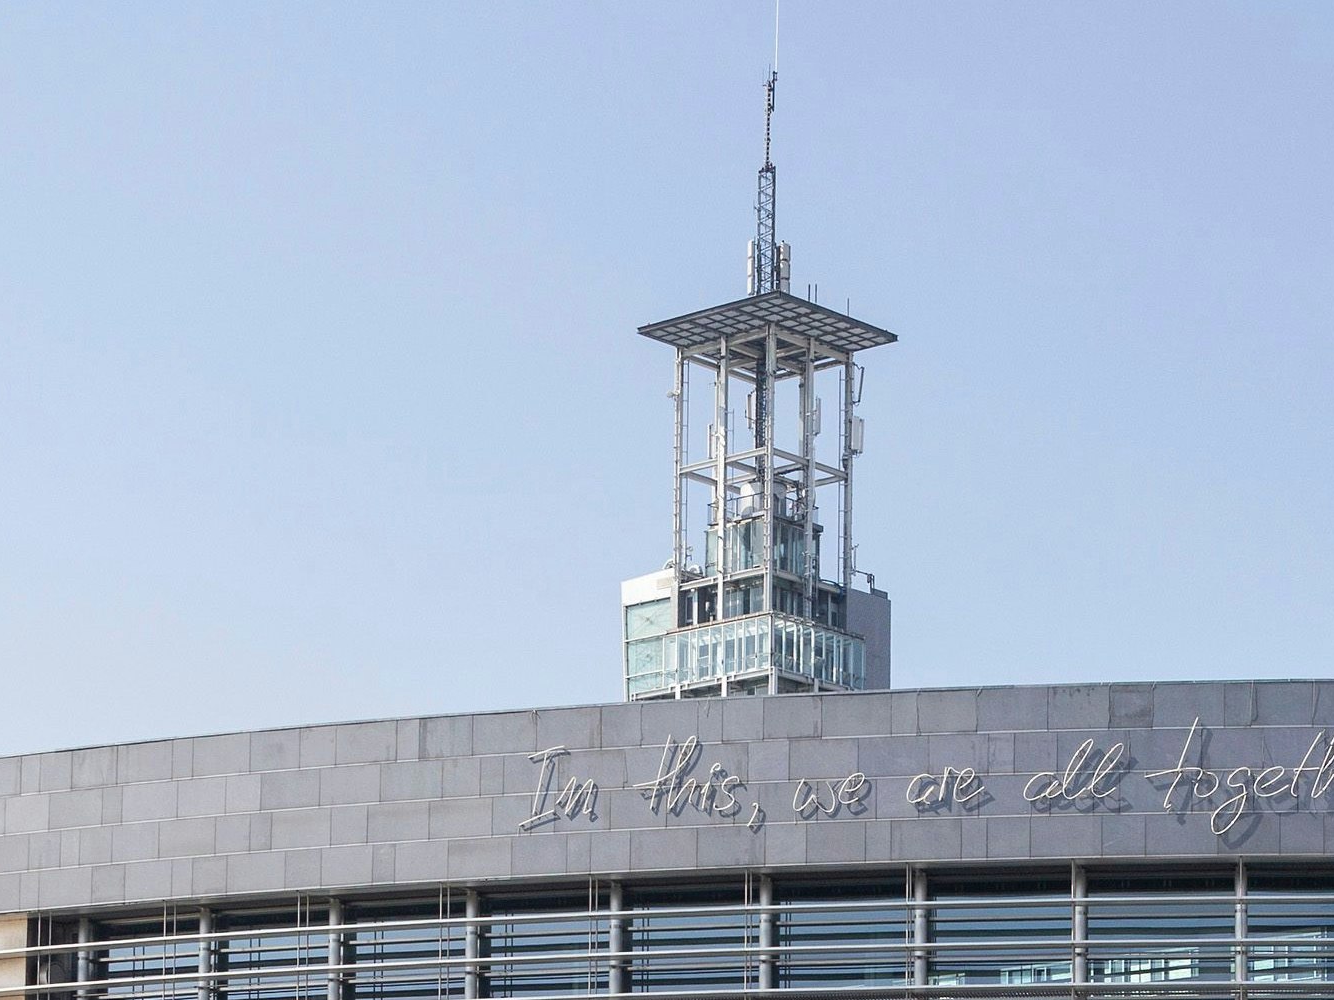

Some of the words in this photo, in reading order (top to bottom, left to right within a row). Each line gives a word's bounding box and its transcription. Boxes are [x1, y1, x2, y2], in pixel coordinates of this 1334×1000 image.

[519, 745, 593, 826] In
[632, 734, 760, 828] this,
[793, 771, 866, 813] we
[907, 766, 985, 805] are
[1023, 738, 1124, 801] all
